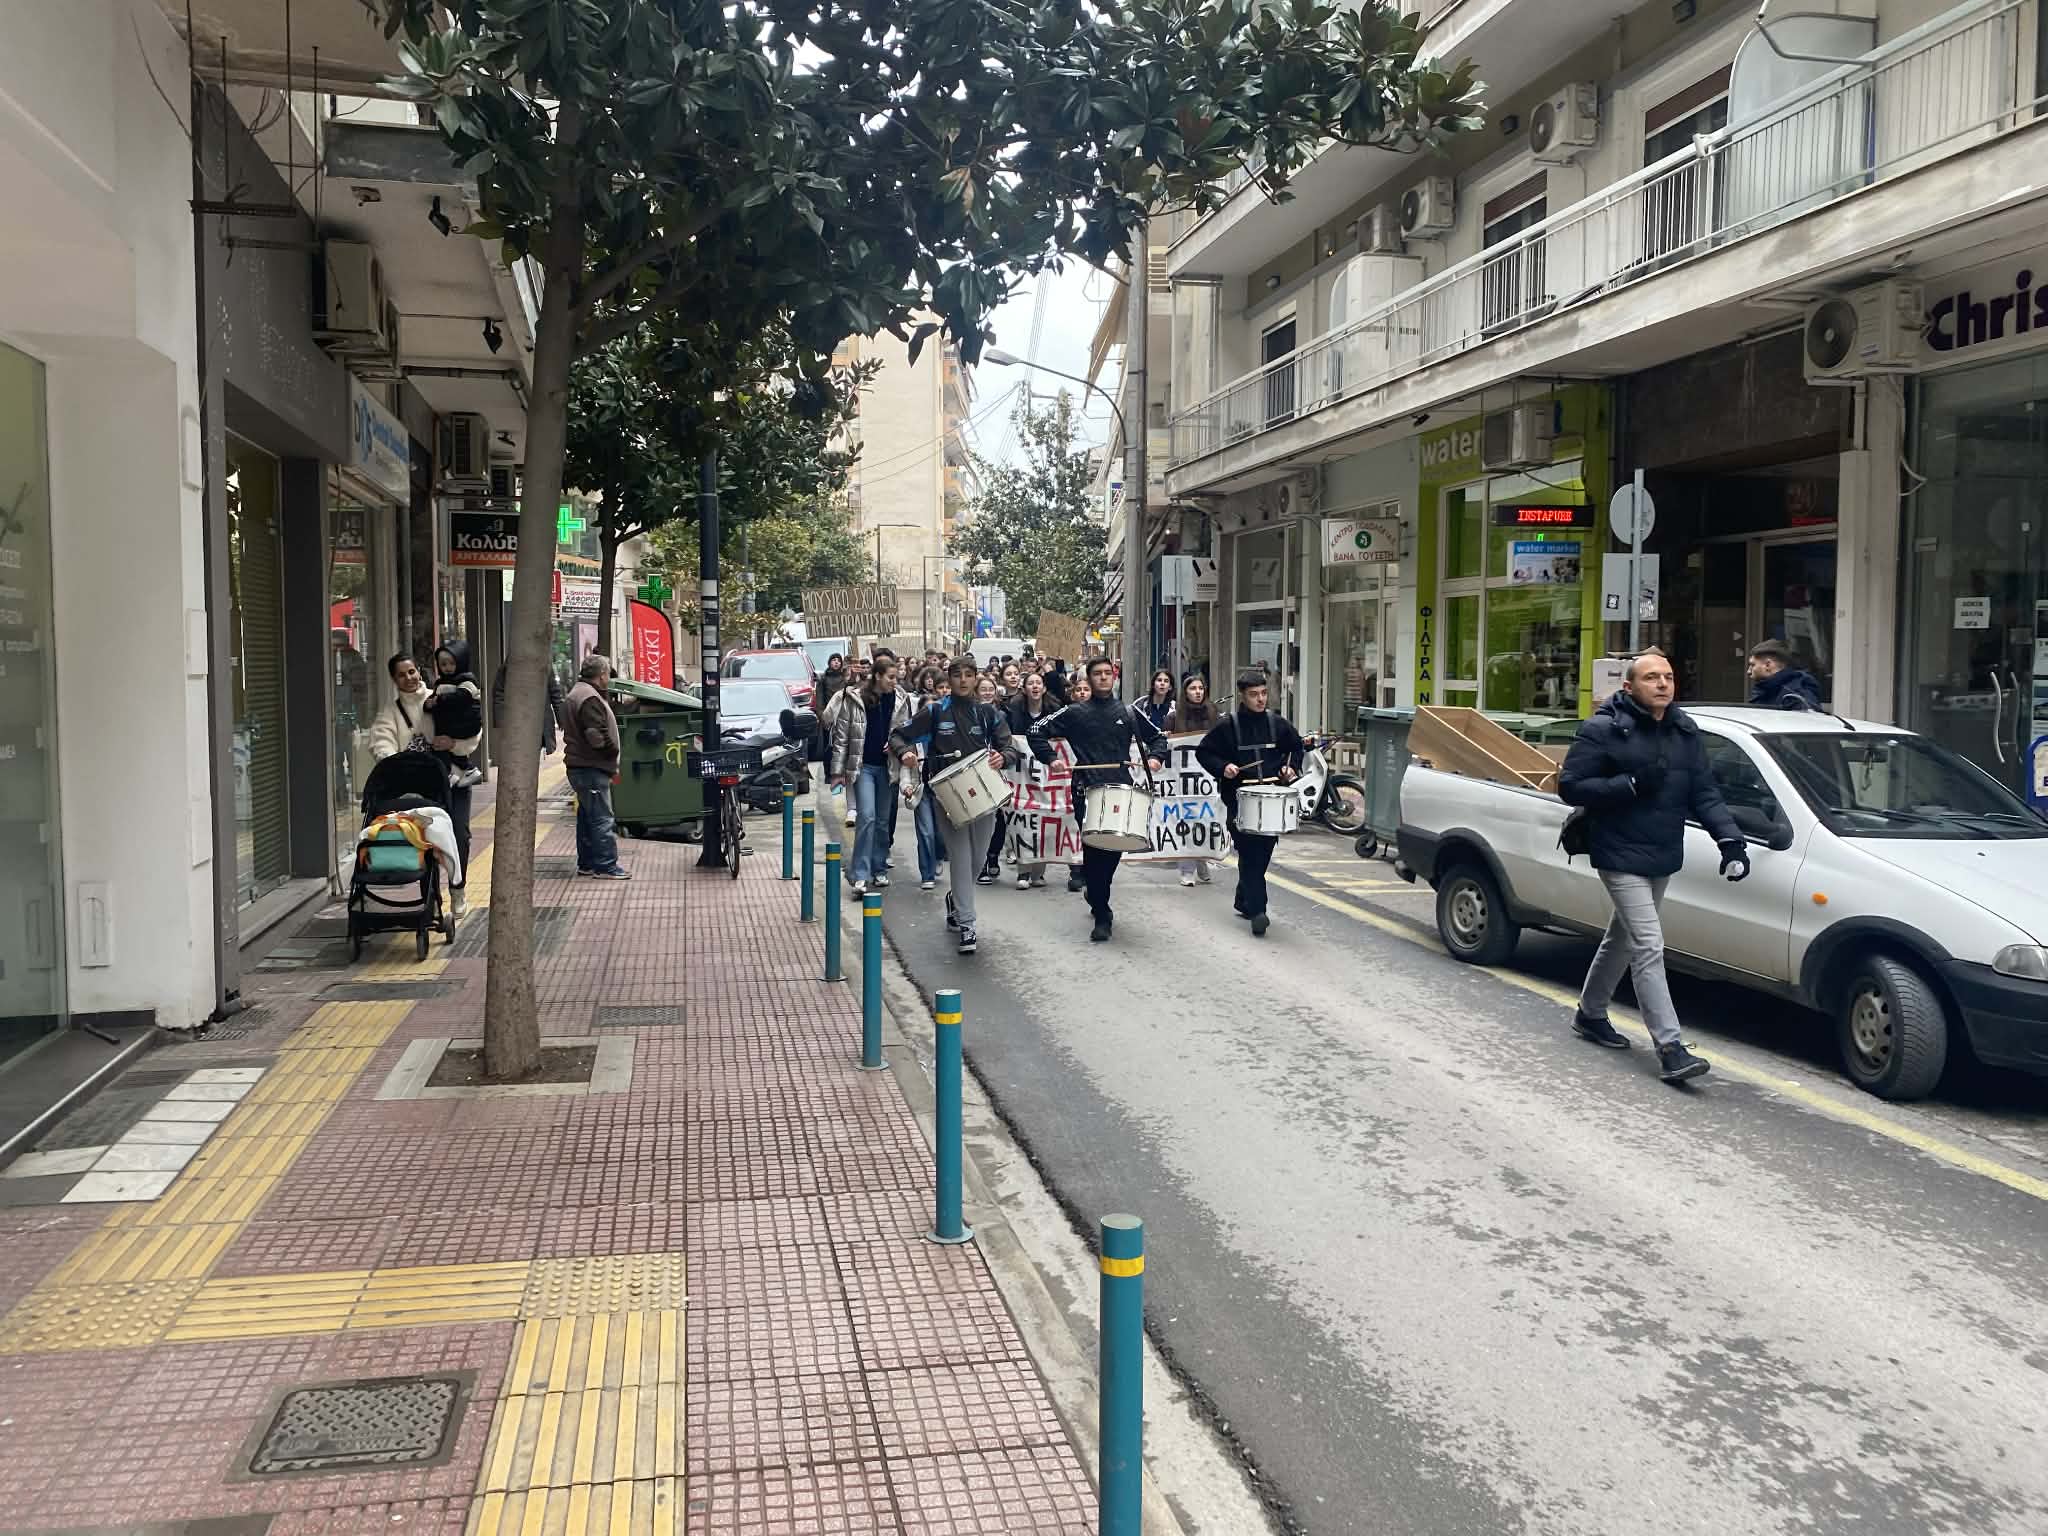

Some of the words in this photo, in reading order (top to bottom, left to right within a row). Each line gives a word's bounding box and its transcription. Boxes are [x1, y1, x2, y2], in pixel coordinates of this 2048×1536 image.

[1516, 544, 1544, 553] water
[801, 588, 850, 613] ΜΟΥΣΙΚΟ
[853, 585, 898, 611] ΣΧΟΛΕΙΟ
[805, 614, 840, 638] ΠΗΓΗ
[1420, 606, 1432, 680] ΦΙΛΤΡΑ
